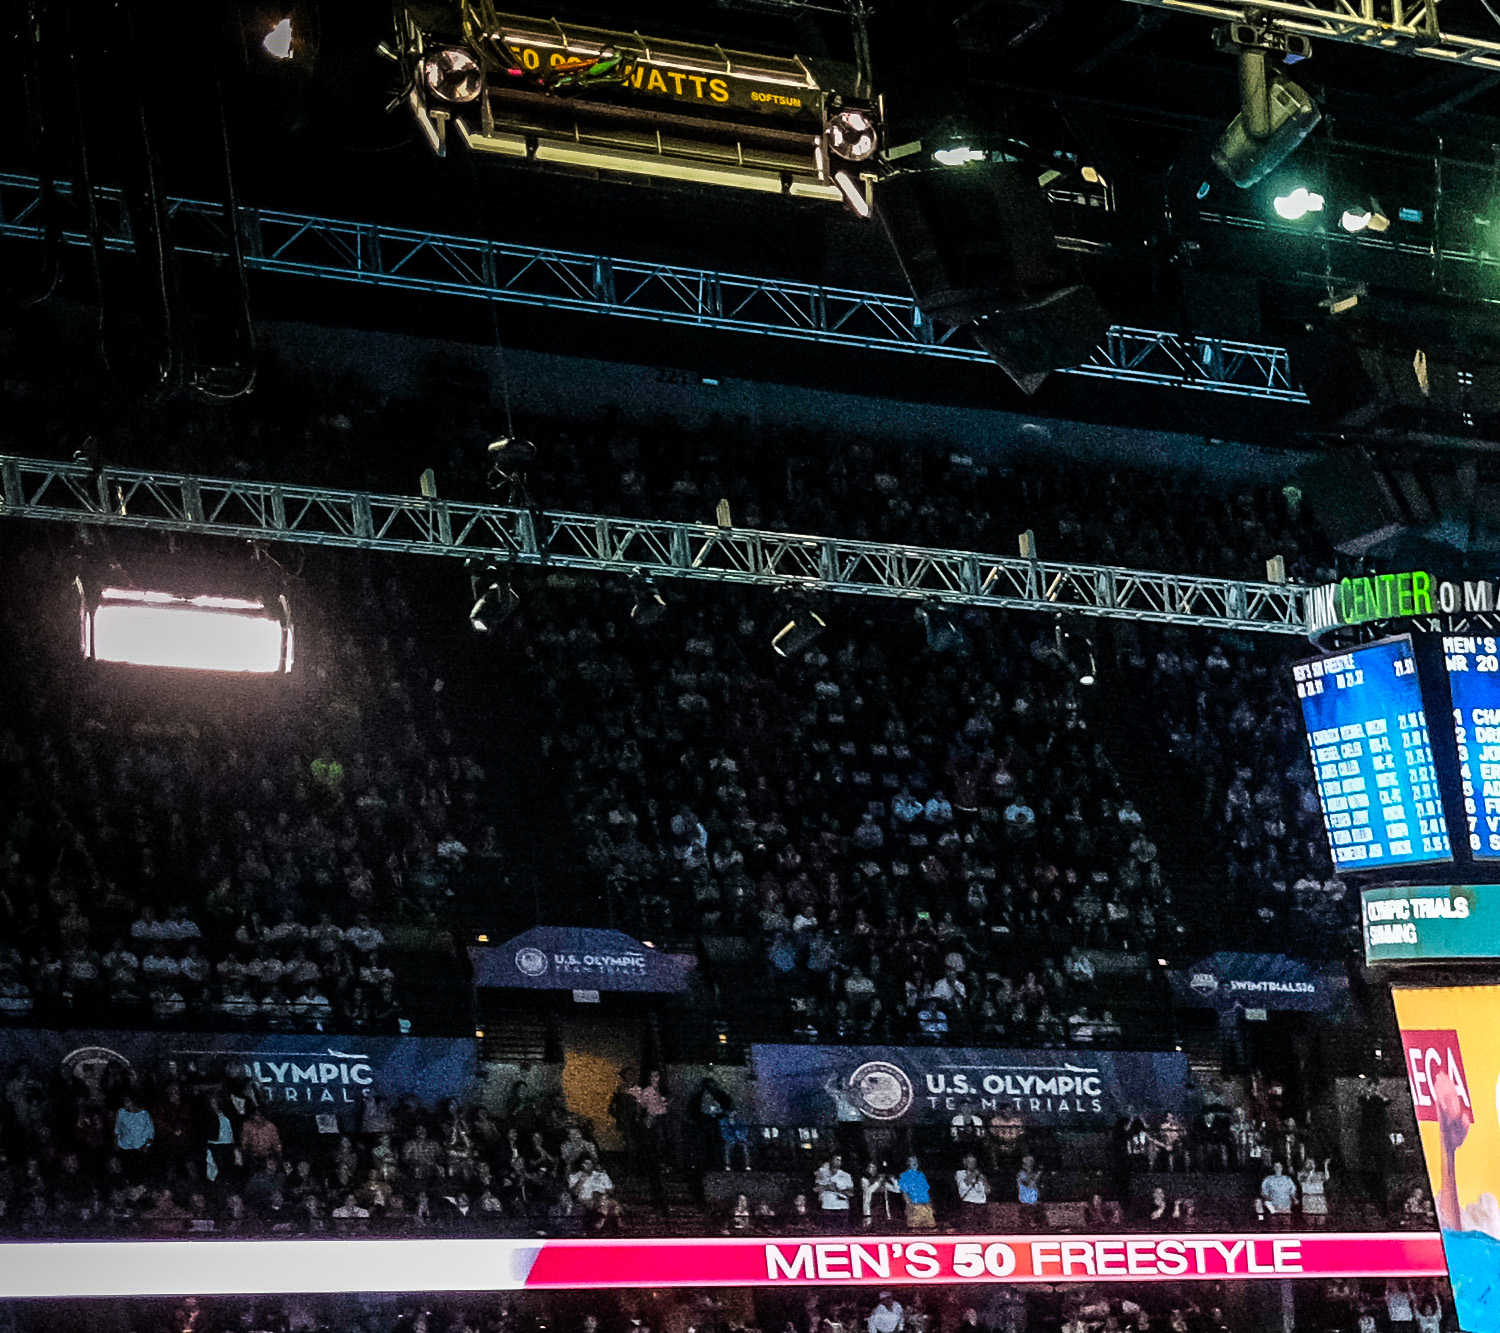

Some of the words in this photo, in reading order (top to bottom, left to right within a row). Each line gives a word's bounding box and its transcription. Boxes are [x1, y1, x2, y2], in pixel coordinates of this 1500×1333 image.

[1340, 571, 1432, 623] CENTER
[1443, 637, 1496, 653] MEN'S
[1445, 656, 1468, 672] WR
[1453, 709, 1462, 725] 1
[1456, 728, 1466, 743] 2
[1458, 746, 1468, 761] 3
[1461, 763, 1471, 779] 4
[1463, 781, 1474, 796] 5
[1466, 799, 1476, 814] 6
[1468, 817, 1477, 832] 7
[1470, 835, 1481, 850] 8
[1410, 897, 1469, 918] TRIALS
[584, 955, 645, 967] OLYMPIC
[926, 1074, 977, 1095] U.S.
[983, 1074, 1101, 1097] OLYMPIC
[1015, 1098, 1101, 1113] TRIALS
[765, 1243, 938, 1280] MEN'S
[953, 1243, 1016, 1277] 50
[1032, 1240, 1302, 1276] FREESTYLE
